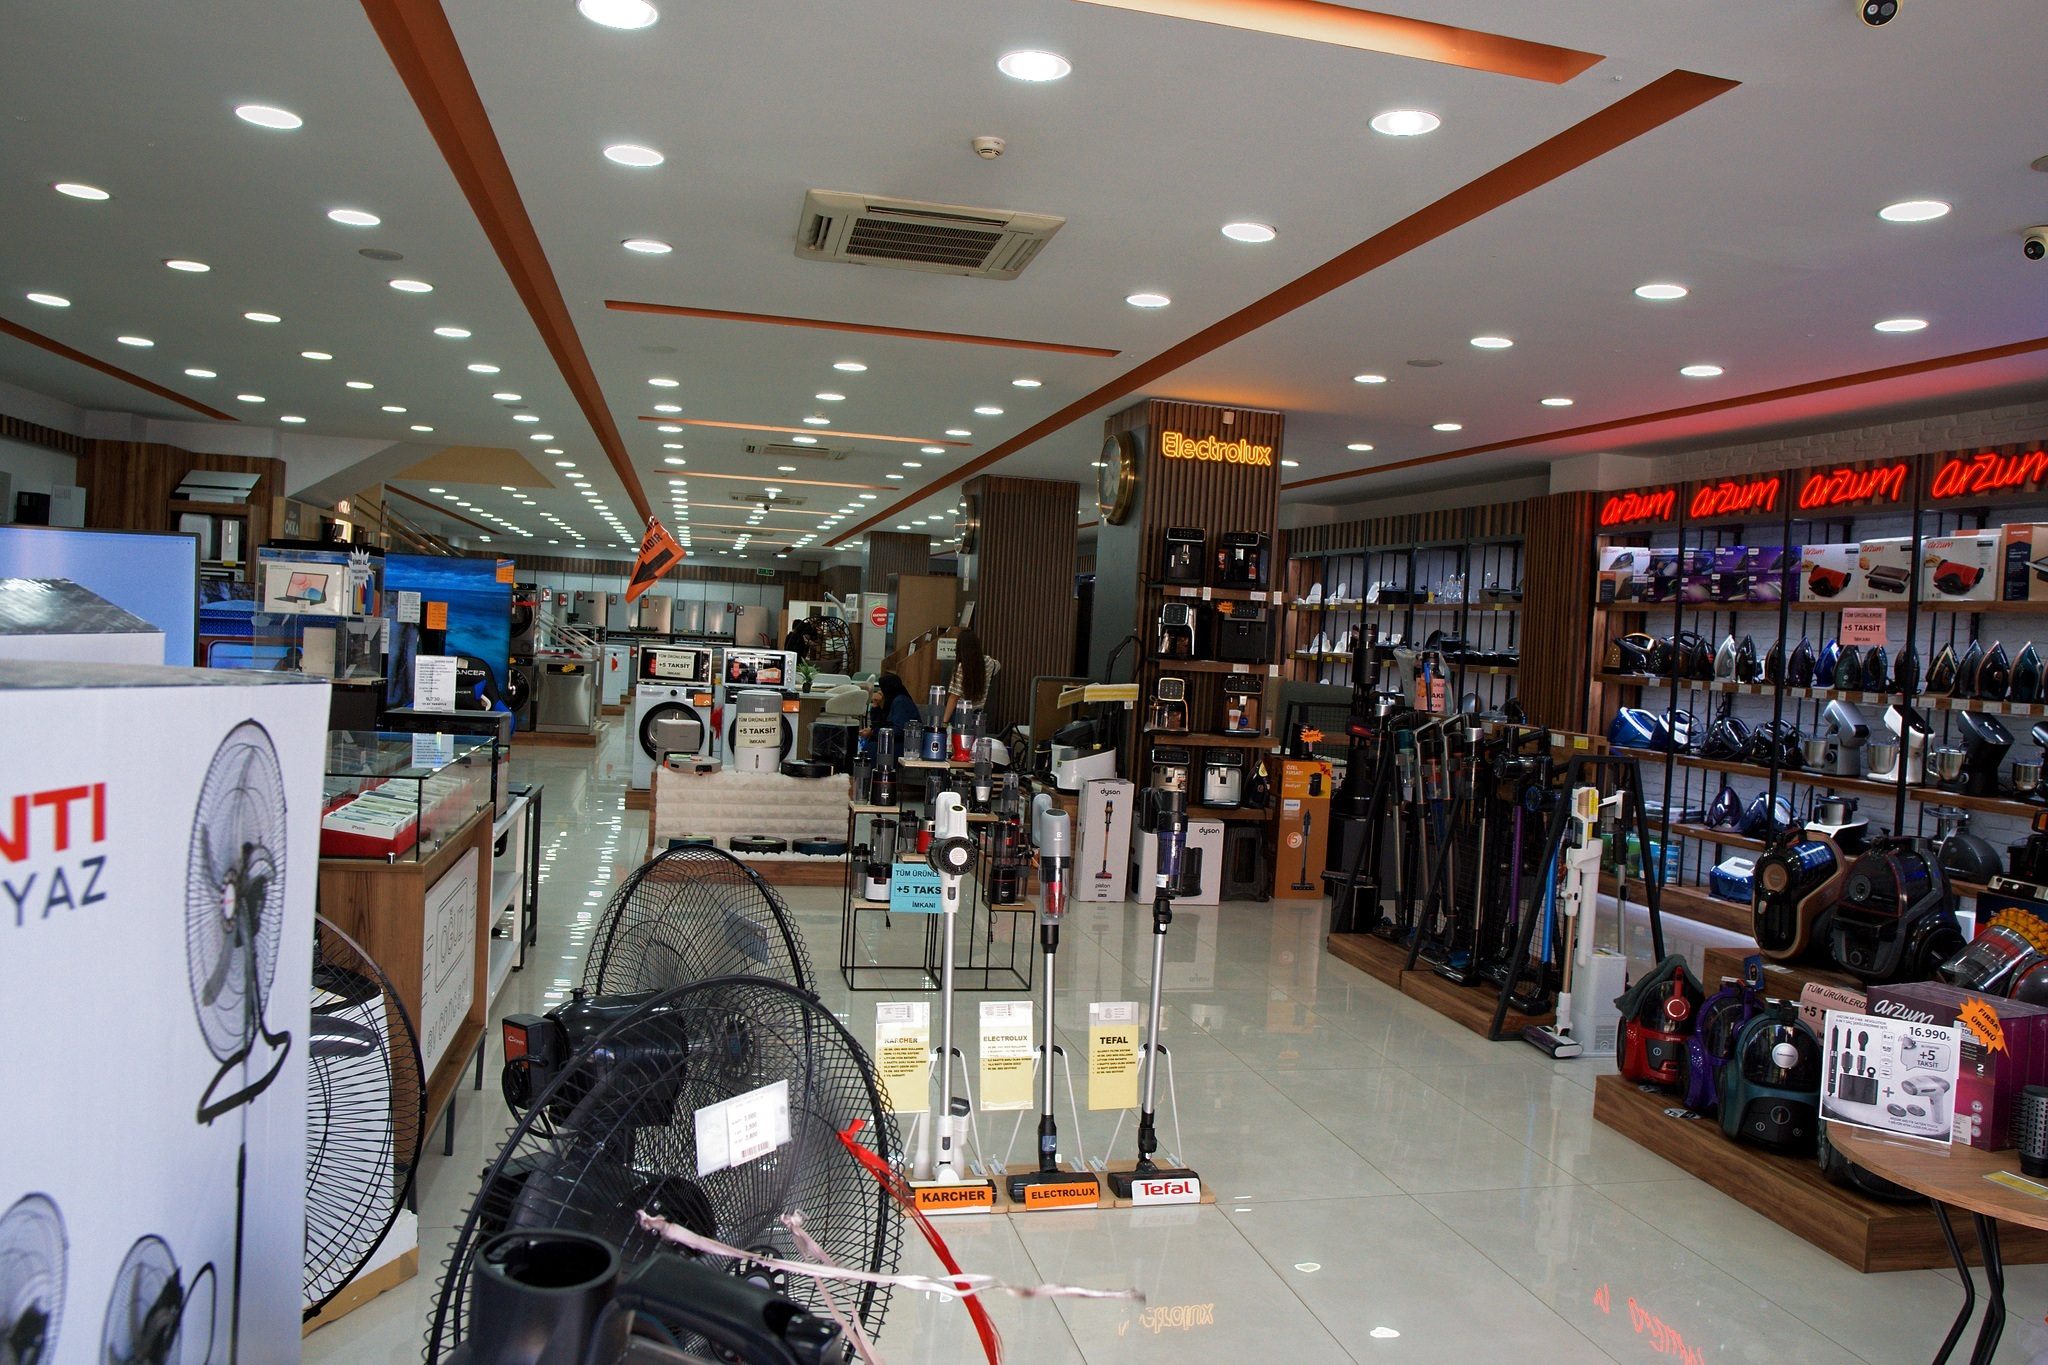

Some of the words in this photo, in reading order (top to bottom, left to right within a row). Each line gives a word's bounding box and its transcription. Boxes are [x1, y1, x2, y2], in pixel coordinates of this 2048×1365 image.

[1162, 431, 1271, 466] Electrolux
[1932, 450, 2048, 499] arzum
[1800, 463, 1908, 509] arzum
[1690, 477, 1780, 519] arzum
[1600, 489, 1676, 526] arzum
[1861, 544, 1885, 553] arzum
[1927, 541, 1953, 549] arzum
[1804, 548, 1825, 556] arzum
[749, 726, 776, 734] TAKSİT
[1100, 788, 1121, 797] dyson
[1199, 826, 1220, 836] dyson
[896, 869, 910, 877] TÜM
[2, 855, 106, 927] YAZ
[897, 886, 910, 894] +5
[912, 886, 942, 895] TAKS
[1807, 984, 1824, 994] TÜM
[1804, 1005, 1817, 1017] +5
[1873, 999, 1935, 1024] arzum
[1100, 1036, 1128, 1045] TEFAL
[1920, 1050, 1936, 1061] +5
[1917, 1060, 1939, 1068] TAKSİT
[1031, 1187, 1096, 1200] ELECTROLUX
[1140, 1181, 1193, 1196] Tefal
[922, 1190, 986, 1203] KARCHER
